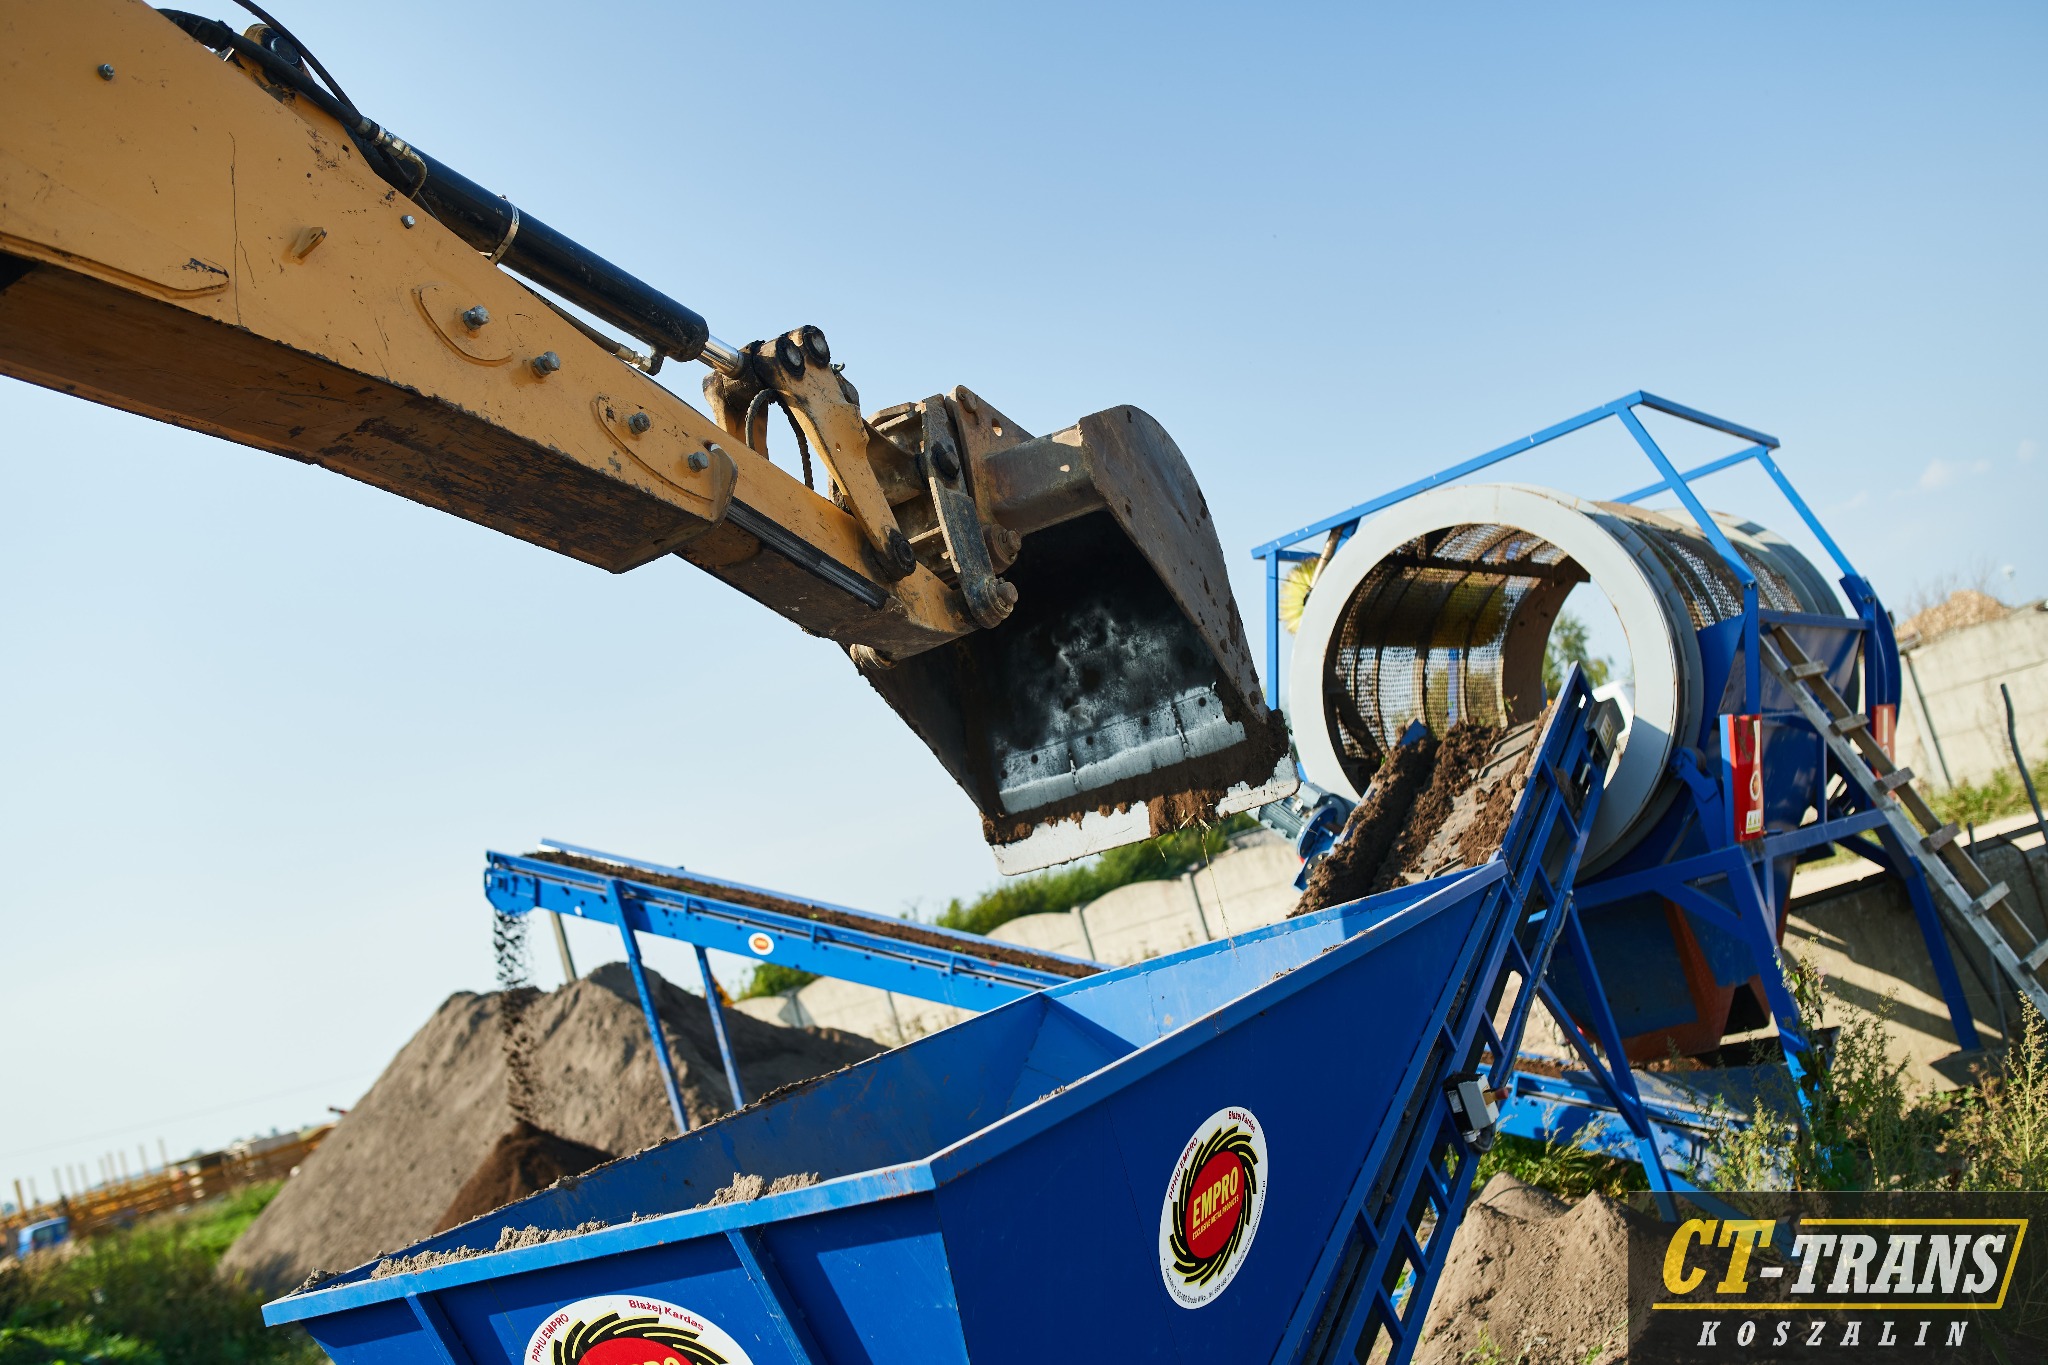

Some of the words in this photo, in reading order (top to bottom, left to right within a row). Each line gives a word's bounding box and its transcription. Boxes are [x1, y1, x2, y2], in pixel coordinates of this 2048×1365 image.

[1168, 1168, 1181, 1200] PPHU
[1179, 1137, 1198, 1168] EMPRO
[1192, 1166, 1239, 1230] EMPRO
[531, 1336, 547, 1363] PPHU
[541, 1313, 569, 1339] EMPRO
[664, 1306, 704, 1331] Kardas
